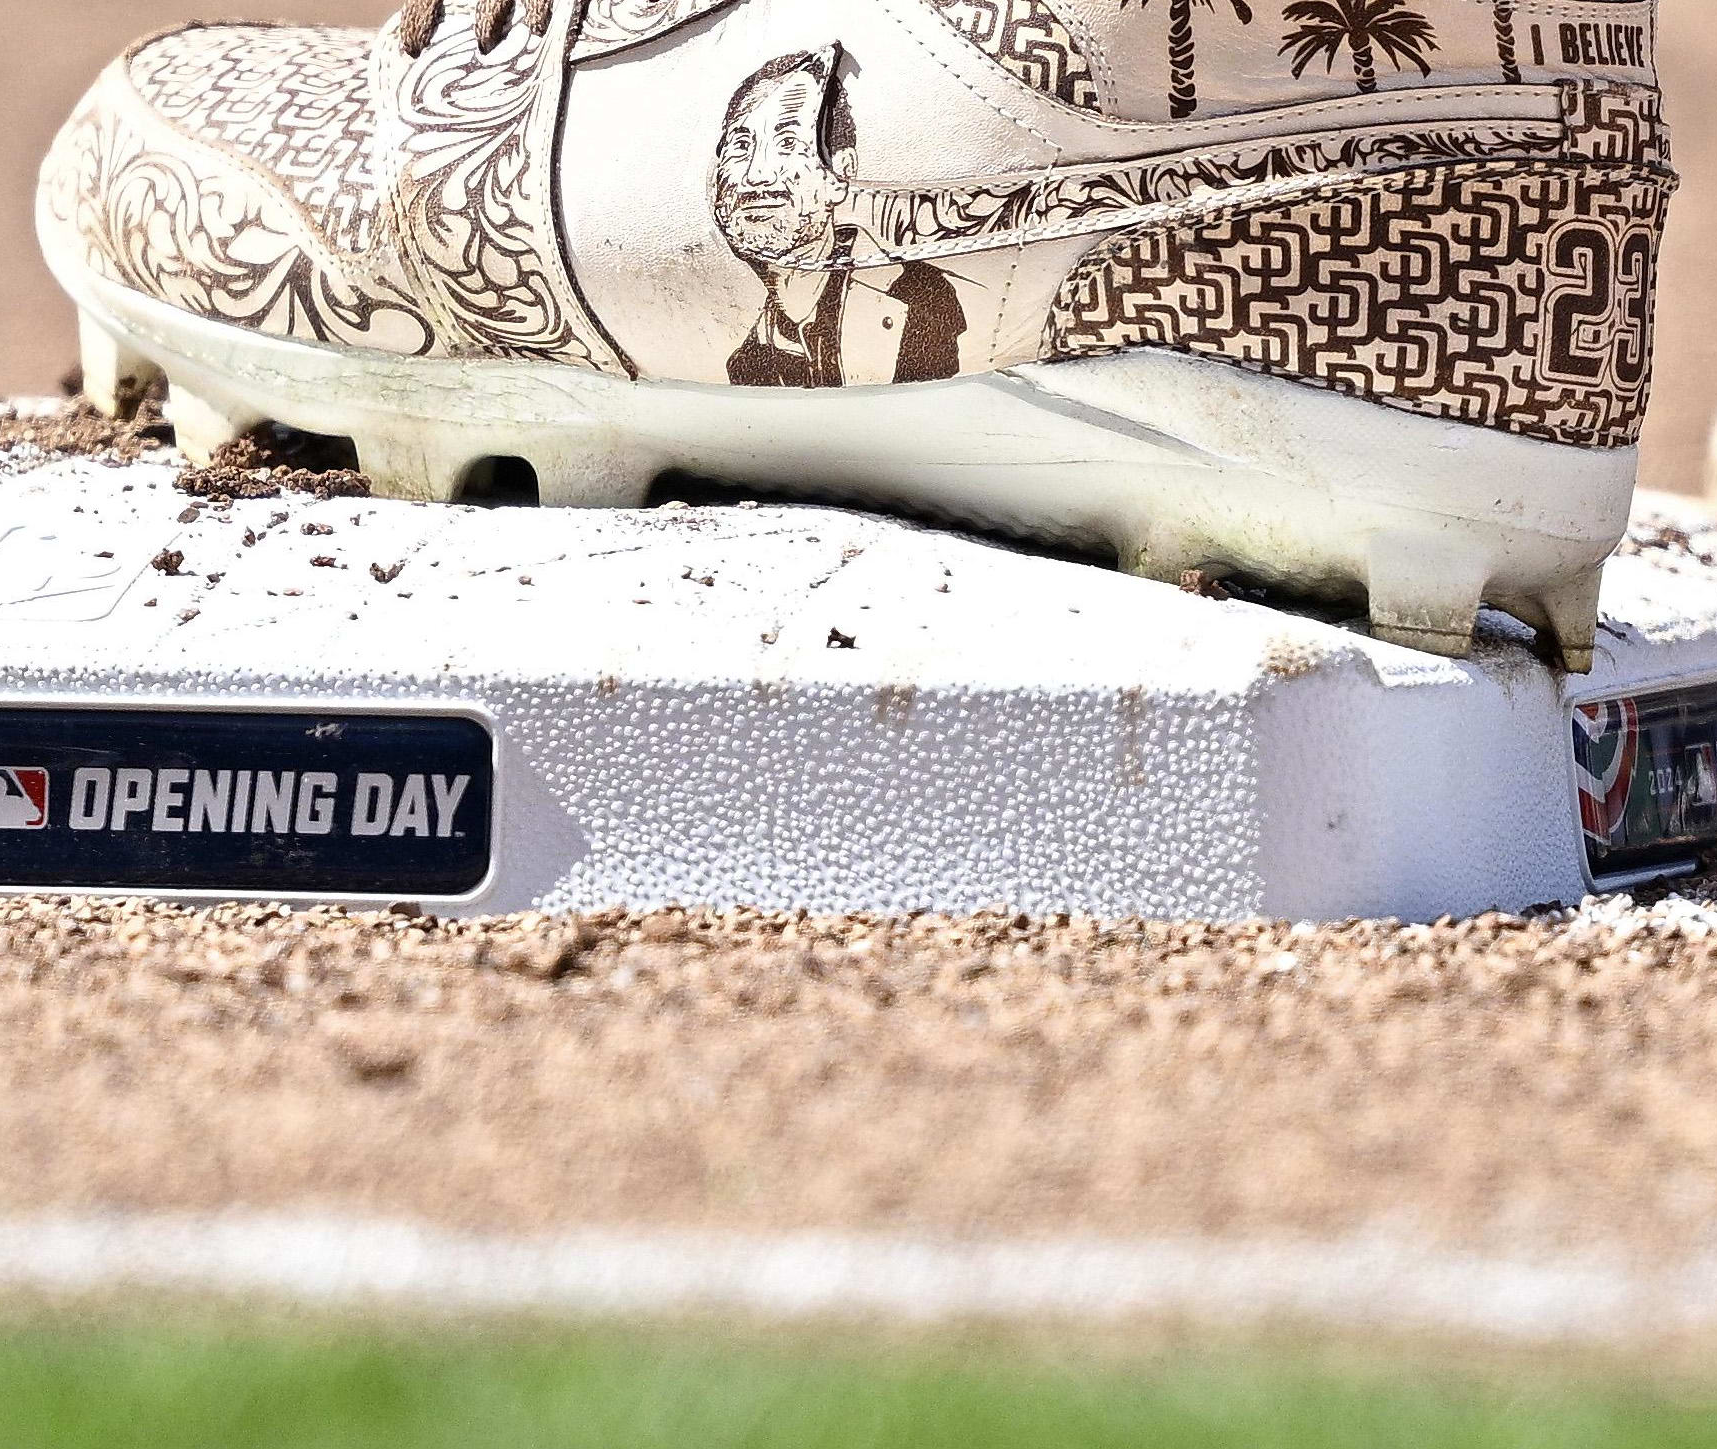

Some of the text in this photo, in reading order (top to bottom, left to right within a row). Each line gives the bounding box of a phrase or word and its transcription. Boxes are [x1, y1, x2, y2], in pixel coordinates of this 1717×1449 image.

[1530, 22, 1645, 68] I BELIEVE
[1540, 221, 1652, 389] 23
[67, 766, 339, 836] OPENING
[350, 772, 472, 838] DAY
